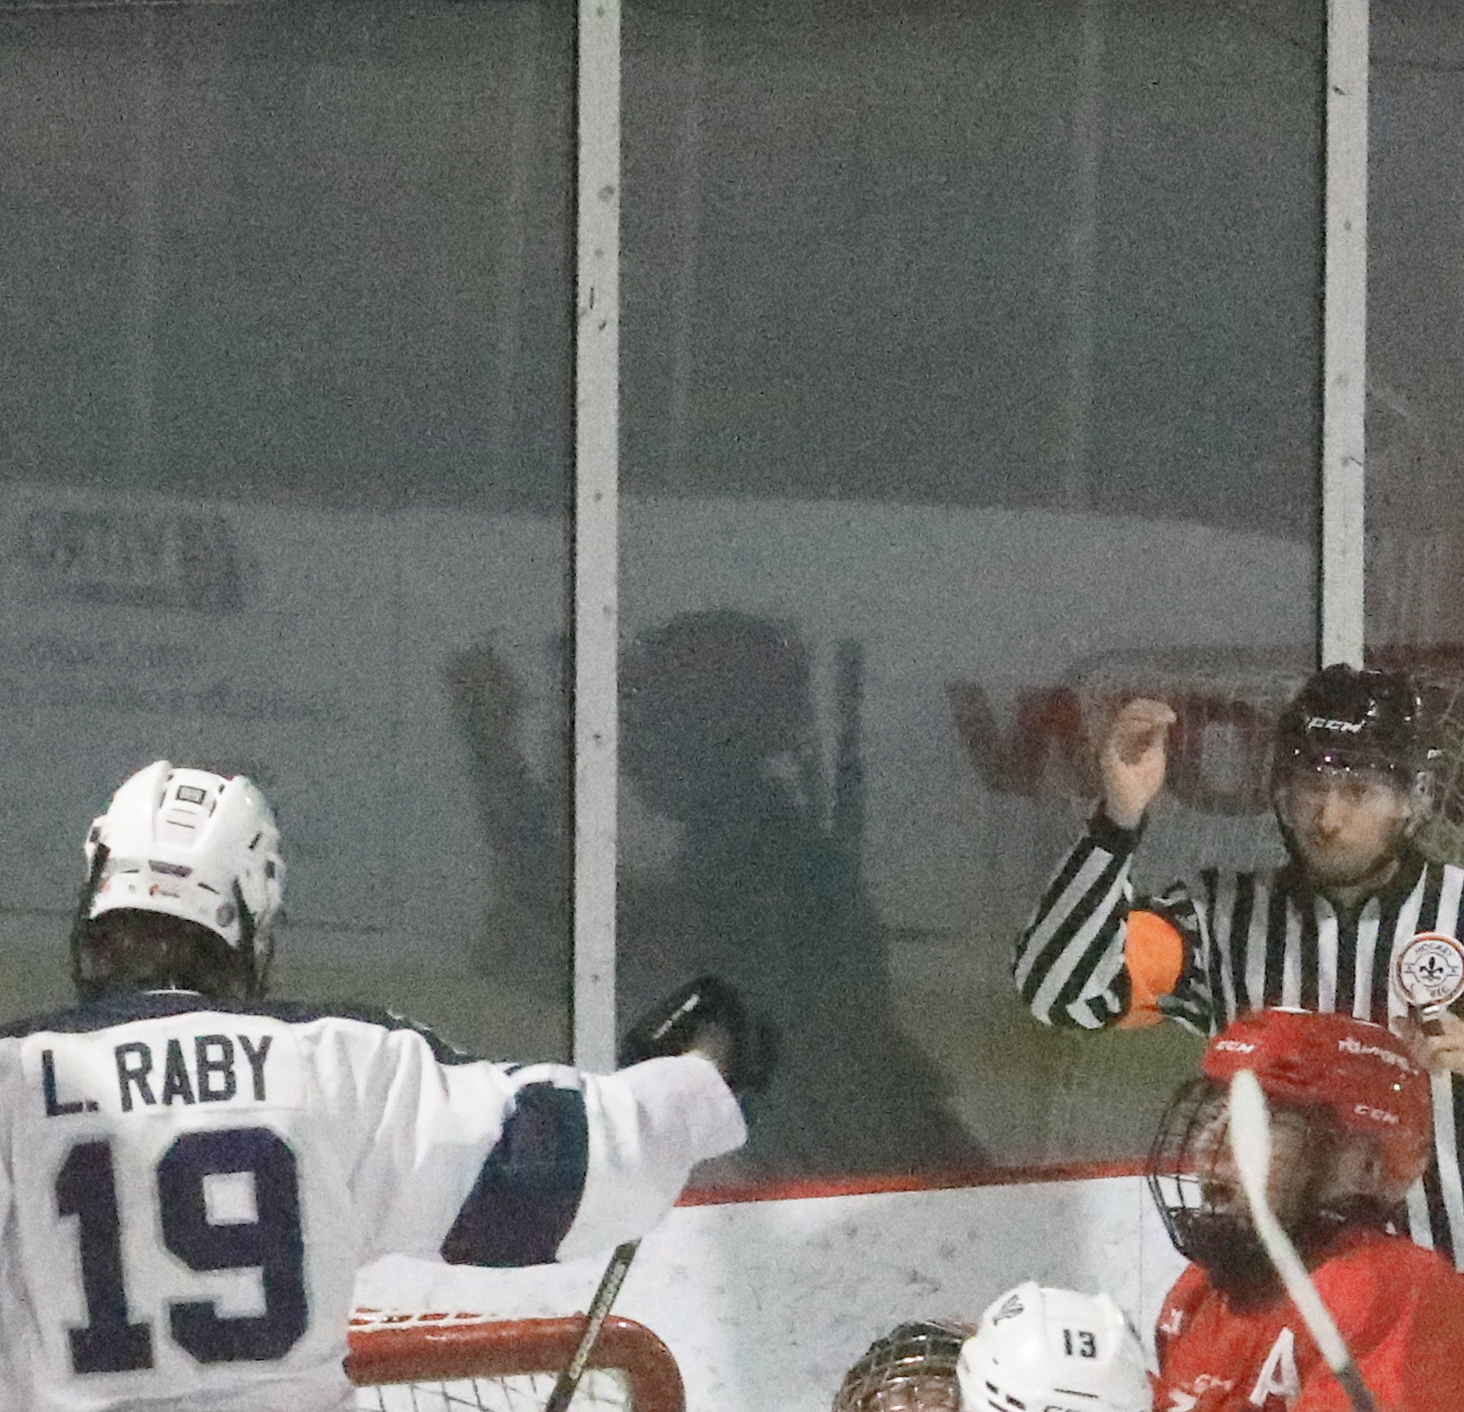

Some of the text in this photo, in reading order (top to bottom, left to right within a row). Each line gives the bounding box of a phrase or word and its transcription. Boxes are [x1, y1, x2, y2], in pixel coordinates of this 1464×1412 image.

[1307, 716, 1365, 734] CCM
[43, 1033, 274, 1117] L. RABY
[53, 1126, 309, 1375] 19
[1061, 1327, 1099, 1359] 13
[1248, 1326, 1302, 1409] A
